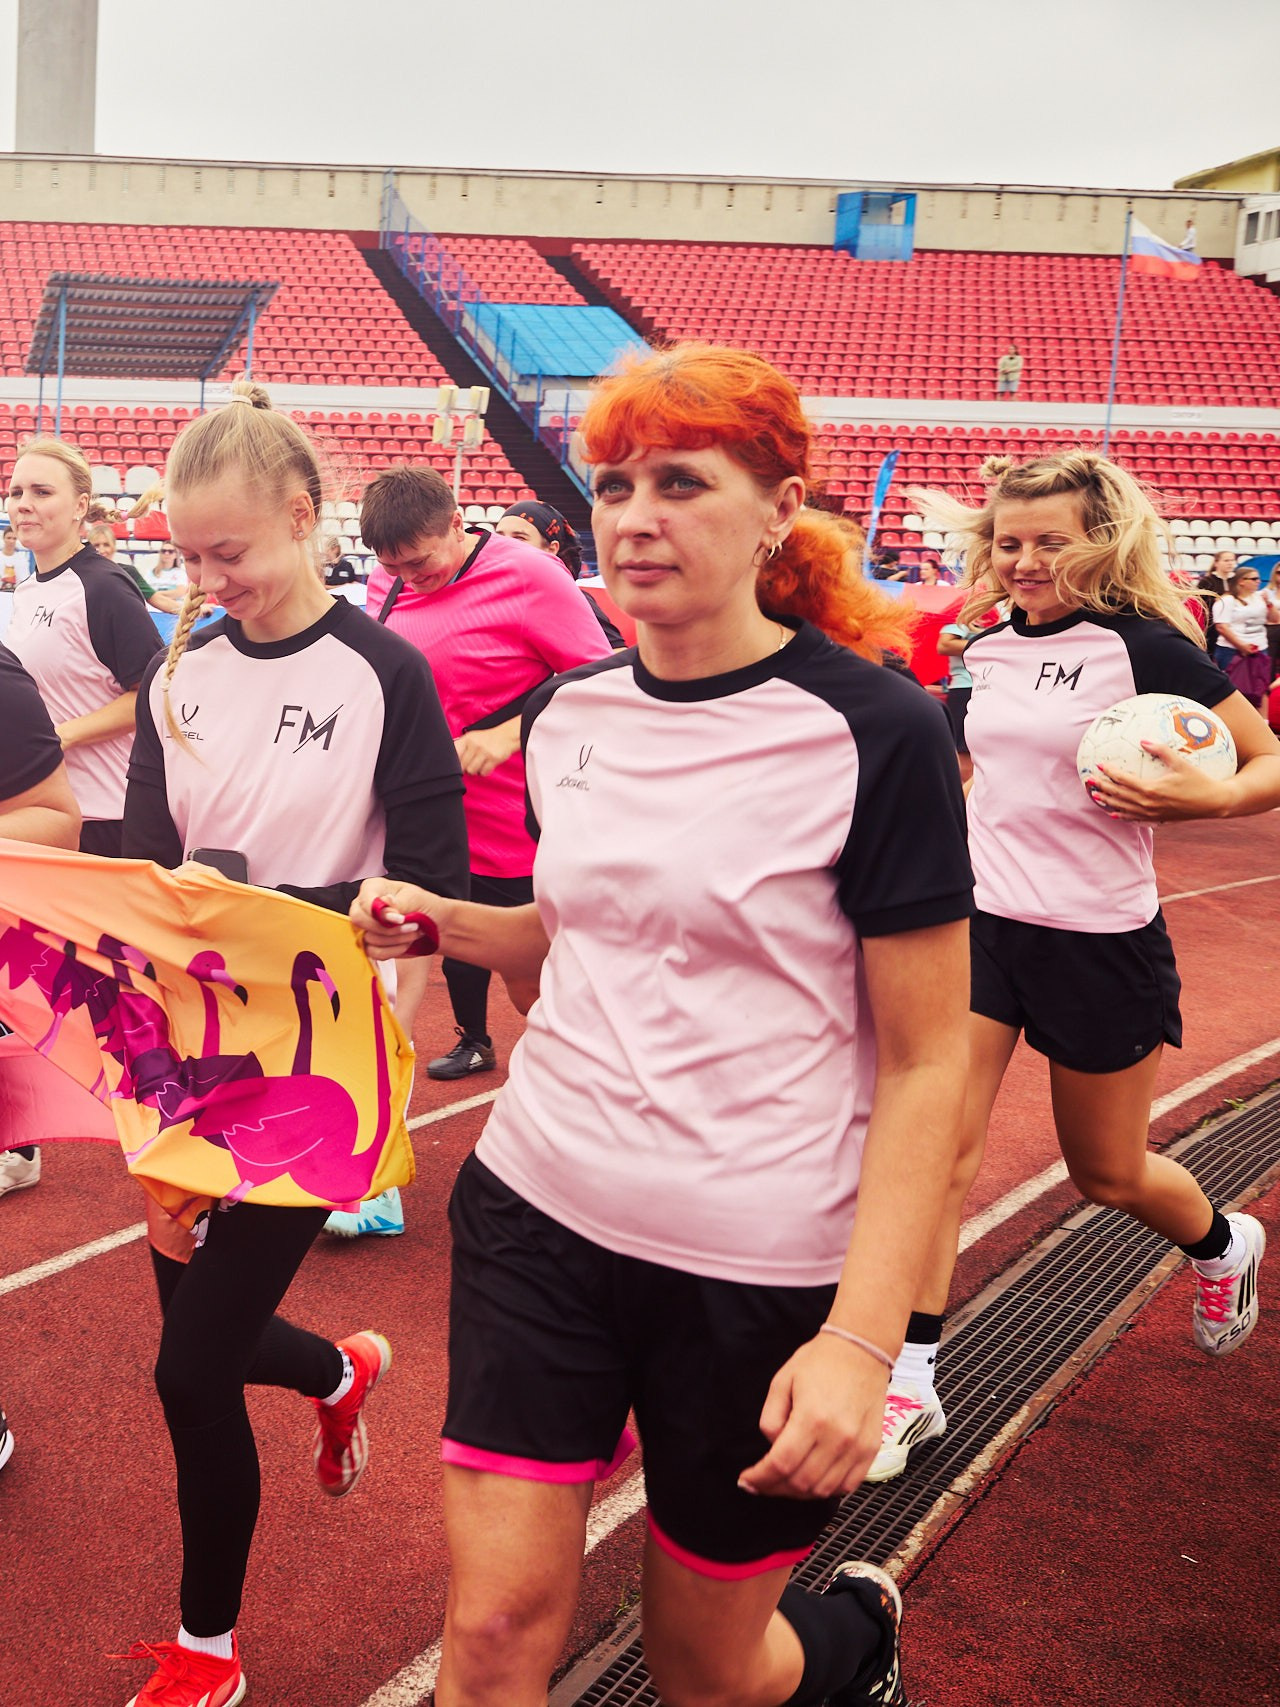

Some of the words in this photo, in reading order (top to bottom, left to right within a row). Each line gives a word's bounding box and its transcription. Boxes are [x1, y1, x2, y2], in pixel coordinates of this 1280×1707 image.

[30, 605, 56, 629] FM
[1034, 657, 1087, 695] FM
[273, 704, 344, 754] FM
